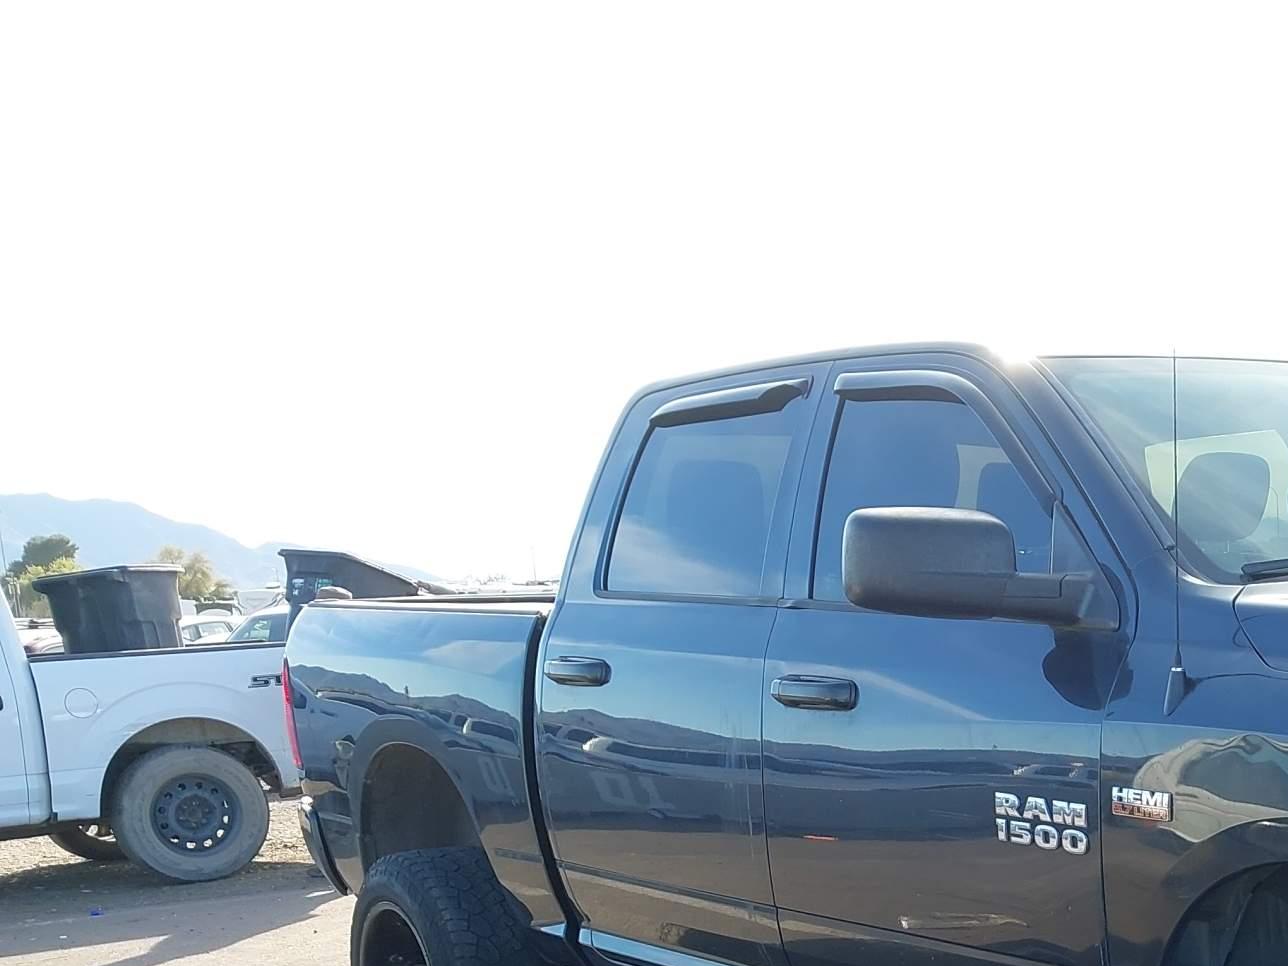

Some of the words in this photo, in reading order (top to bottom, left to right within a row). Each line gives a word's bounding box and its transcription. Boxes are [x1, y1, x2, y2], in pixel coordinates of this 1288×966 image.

[994, 791, 1087, 828] RAM
[1111, 786, 1169, 807] HEMI
[995, 817, 1088, 855] 1500
